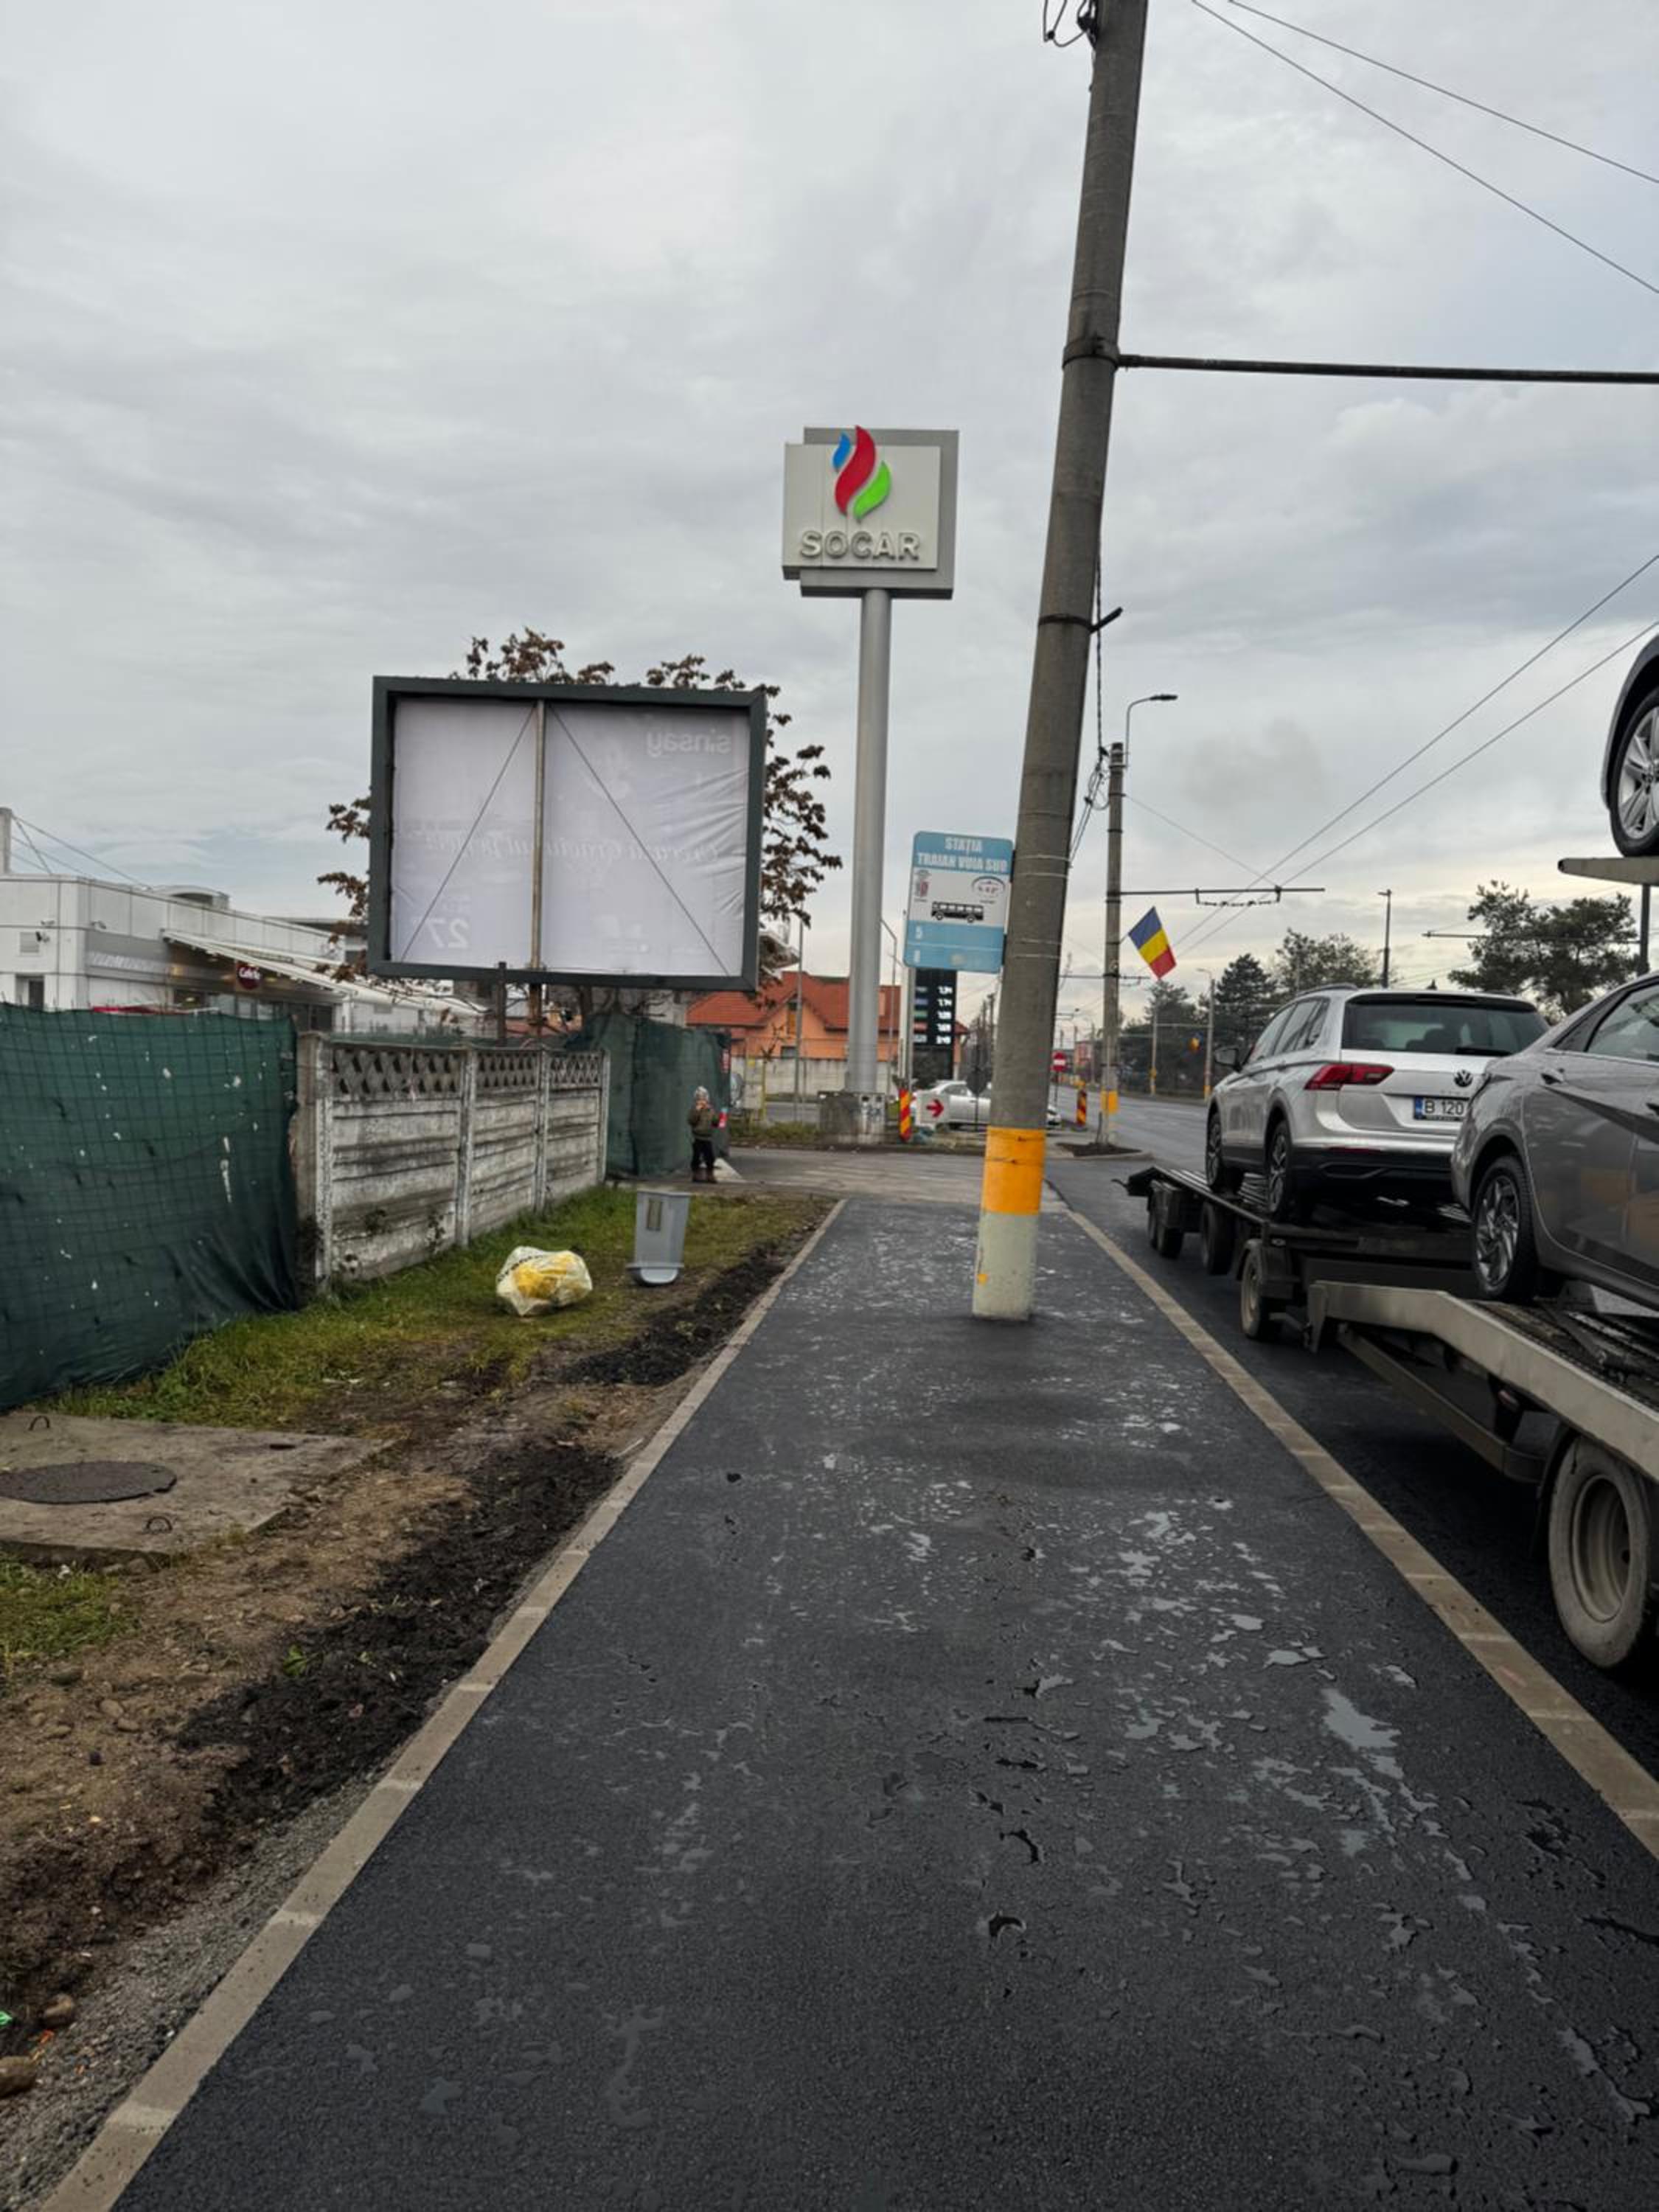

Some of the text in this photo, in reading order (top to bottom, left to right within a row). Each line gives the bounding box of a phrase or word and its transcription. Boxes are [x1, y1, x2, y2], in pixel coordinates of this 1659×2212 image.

[800, 530, 921, 560] SOCAR
[1425, 1099, 1465, 1116] B 120
